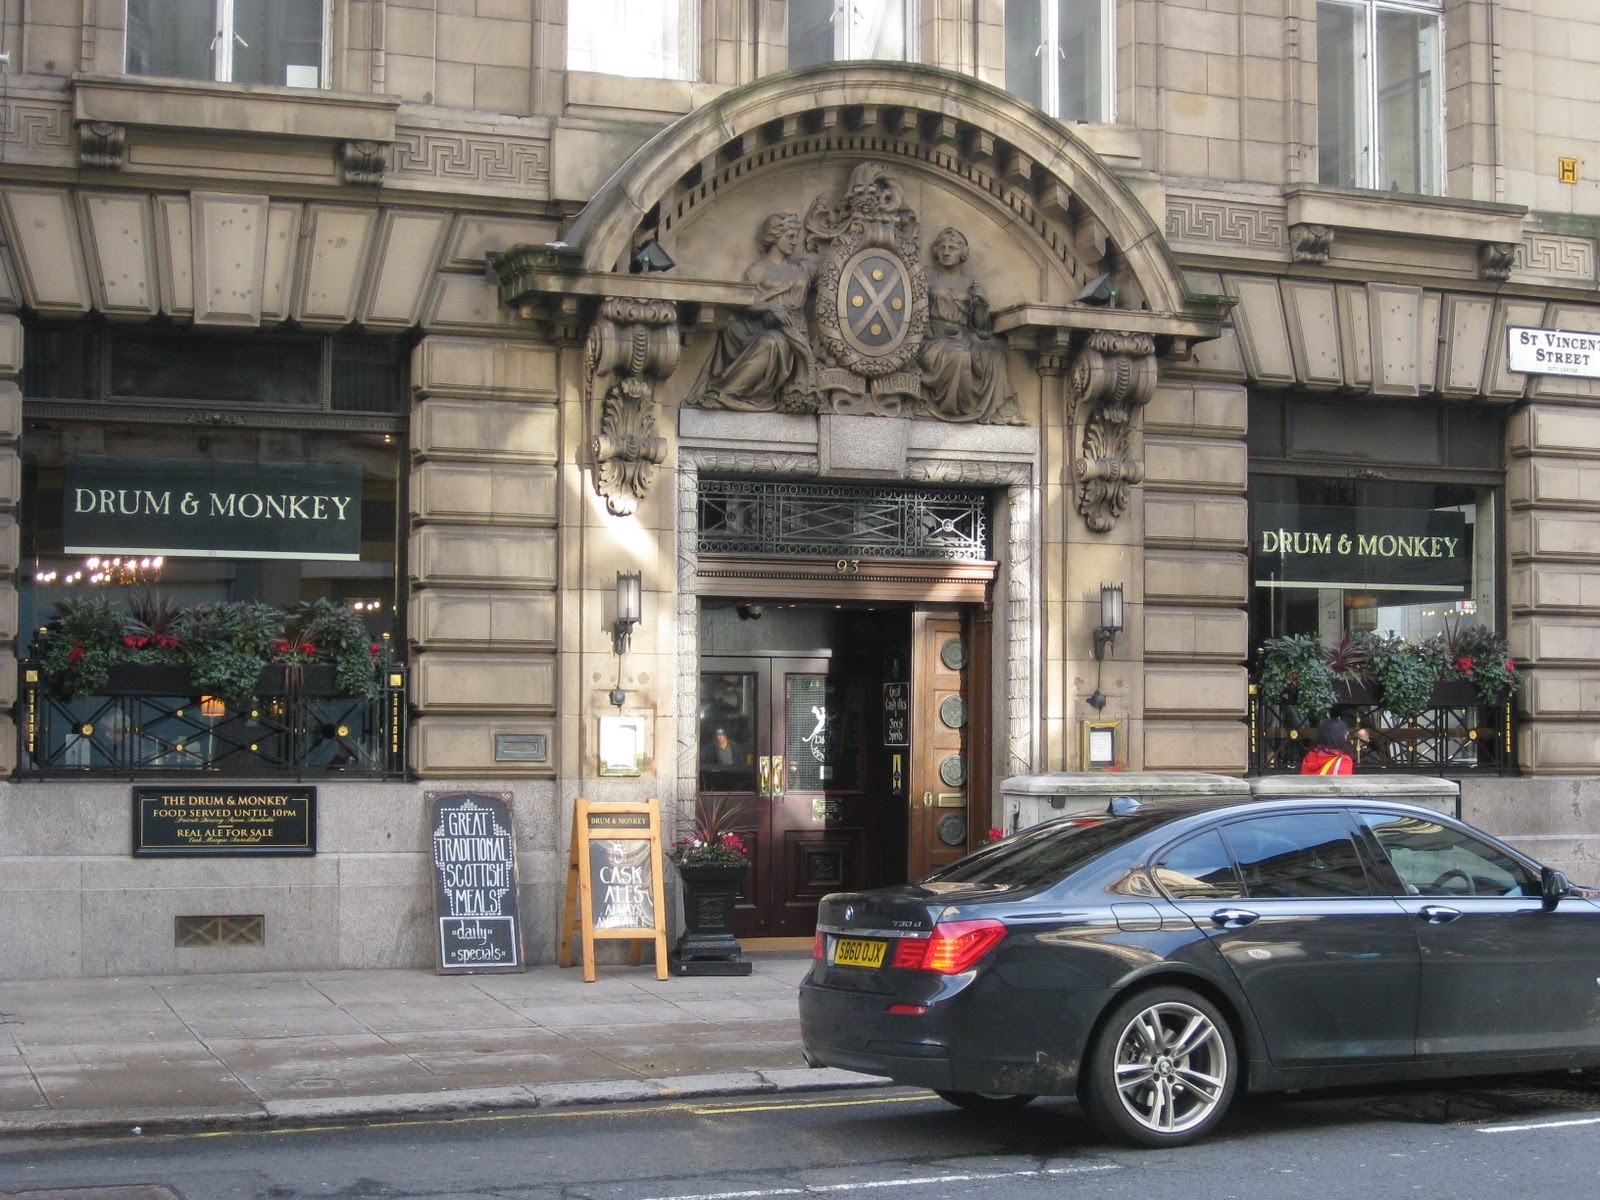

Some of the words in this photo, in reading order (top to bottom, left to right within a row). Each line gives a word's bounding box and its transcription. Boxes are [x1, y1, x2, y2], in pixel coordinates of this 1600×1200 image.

[1536, 348, 1590, 365] STREET
[74, 488, 171, 515] DRUM
[180, 492, 200, 516] &
[209, 492, 351, 520] MONKEY
[1262, 530, 1332, 554] DRUM
[1337, 534, 1352, 555] &
[1358, 534, 1458, 558] MONKEY
[837, 560, 859, 574] 93
[162, 796, 185, 805] THE
[188, 796, 224, 805] DRUM
[226, 796, 237, 805] &
[238, 796, 288, 806] MONKEY
[448, 812, 488, 836] GREAT
[437, 838, 509, 862] TRADITIONAL
[447, 863, 504, 887] SCOTTISH
[600, 866, 643, 884] CASK
[456, 889, 498, 913] MEALS
[604, 885, 644, 903] ALES
[604, 904, 642, 916] ALWAYS
[457, 920, 487, 945] daily
[457, 943, 500, 966] specials
[839, 941, 860, 960] SB60
[861, 943, 883, 962] OJX
